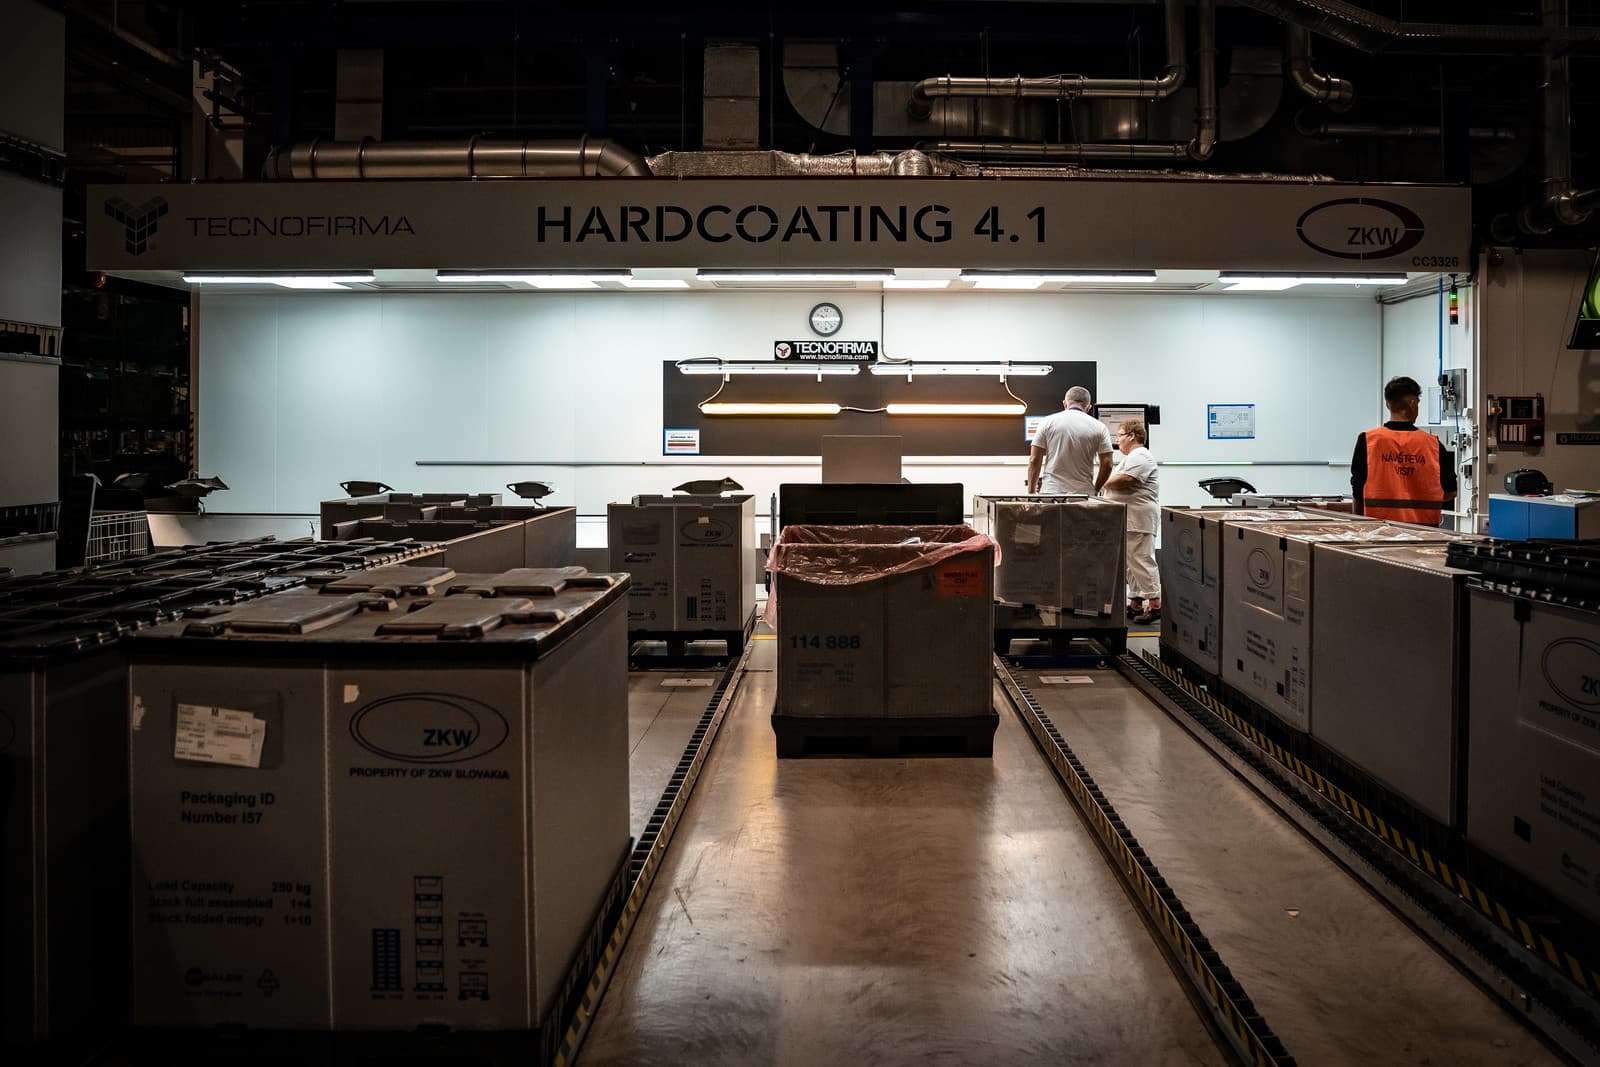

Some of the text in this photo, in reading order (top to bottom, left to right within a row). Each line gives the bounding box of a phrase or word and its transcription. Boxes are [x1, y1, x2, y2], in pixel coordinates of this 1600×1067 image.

[186, 215, 416, 237] TECNOFIRMA
[537, 204, 1048, 243] HARDCOATING 4.1
[1347, 226, 1399, 246] ZKW
[1411, 256, 1460, 268] CC3326
[793, 342, 875, 354] TECNOFIRMA
[1395, 466, 1417, 477] VISIT
[790, 635, 821, 649] 114
[1580, 675, 1600, 697] ZK
[423, 729, 473, 747] ZKW
[349, 767, 510, 780] PROPERTY OF ZKW SLOVAKIA
[181, 791, 276, 807] Packaging ID
[181, 810, 237, 824] Number
[148, 879, 178, 891] Load
[182, 880, 235, 894] Capacity
